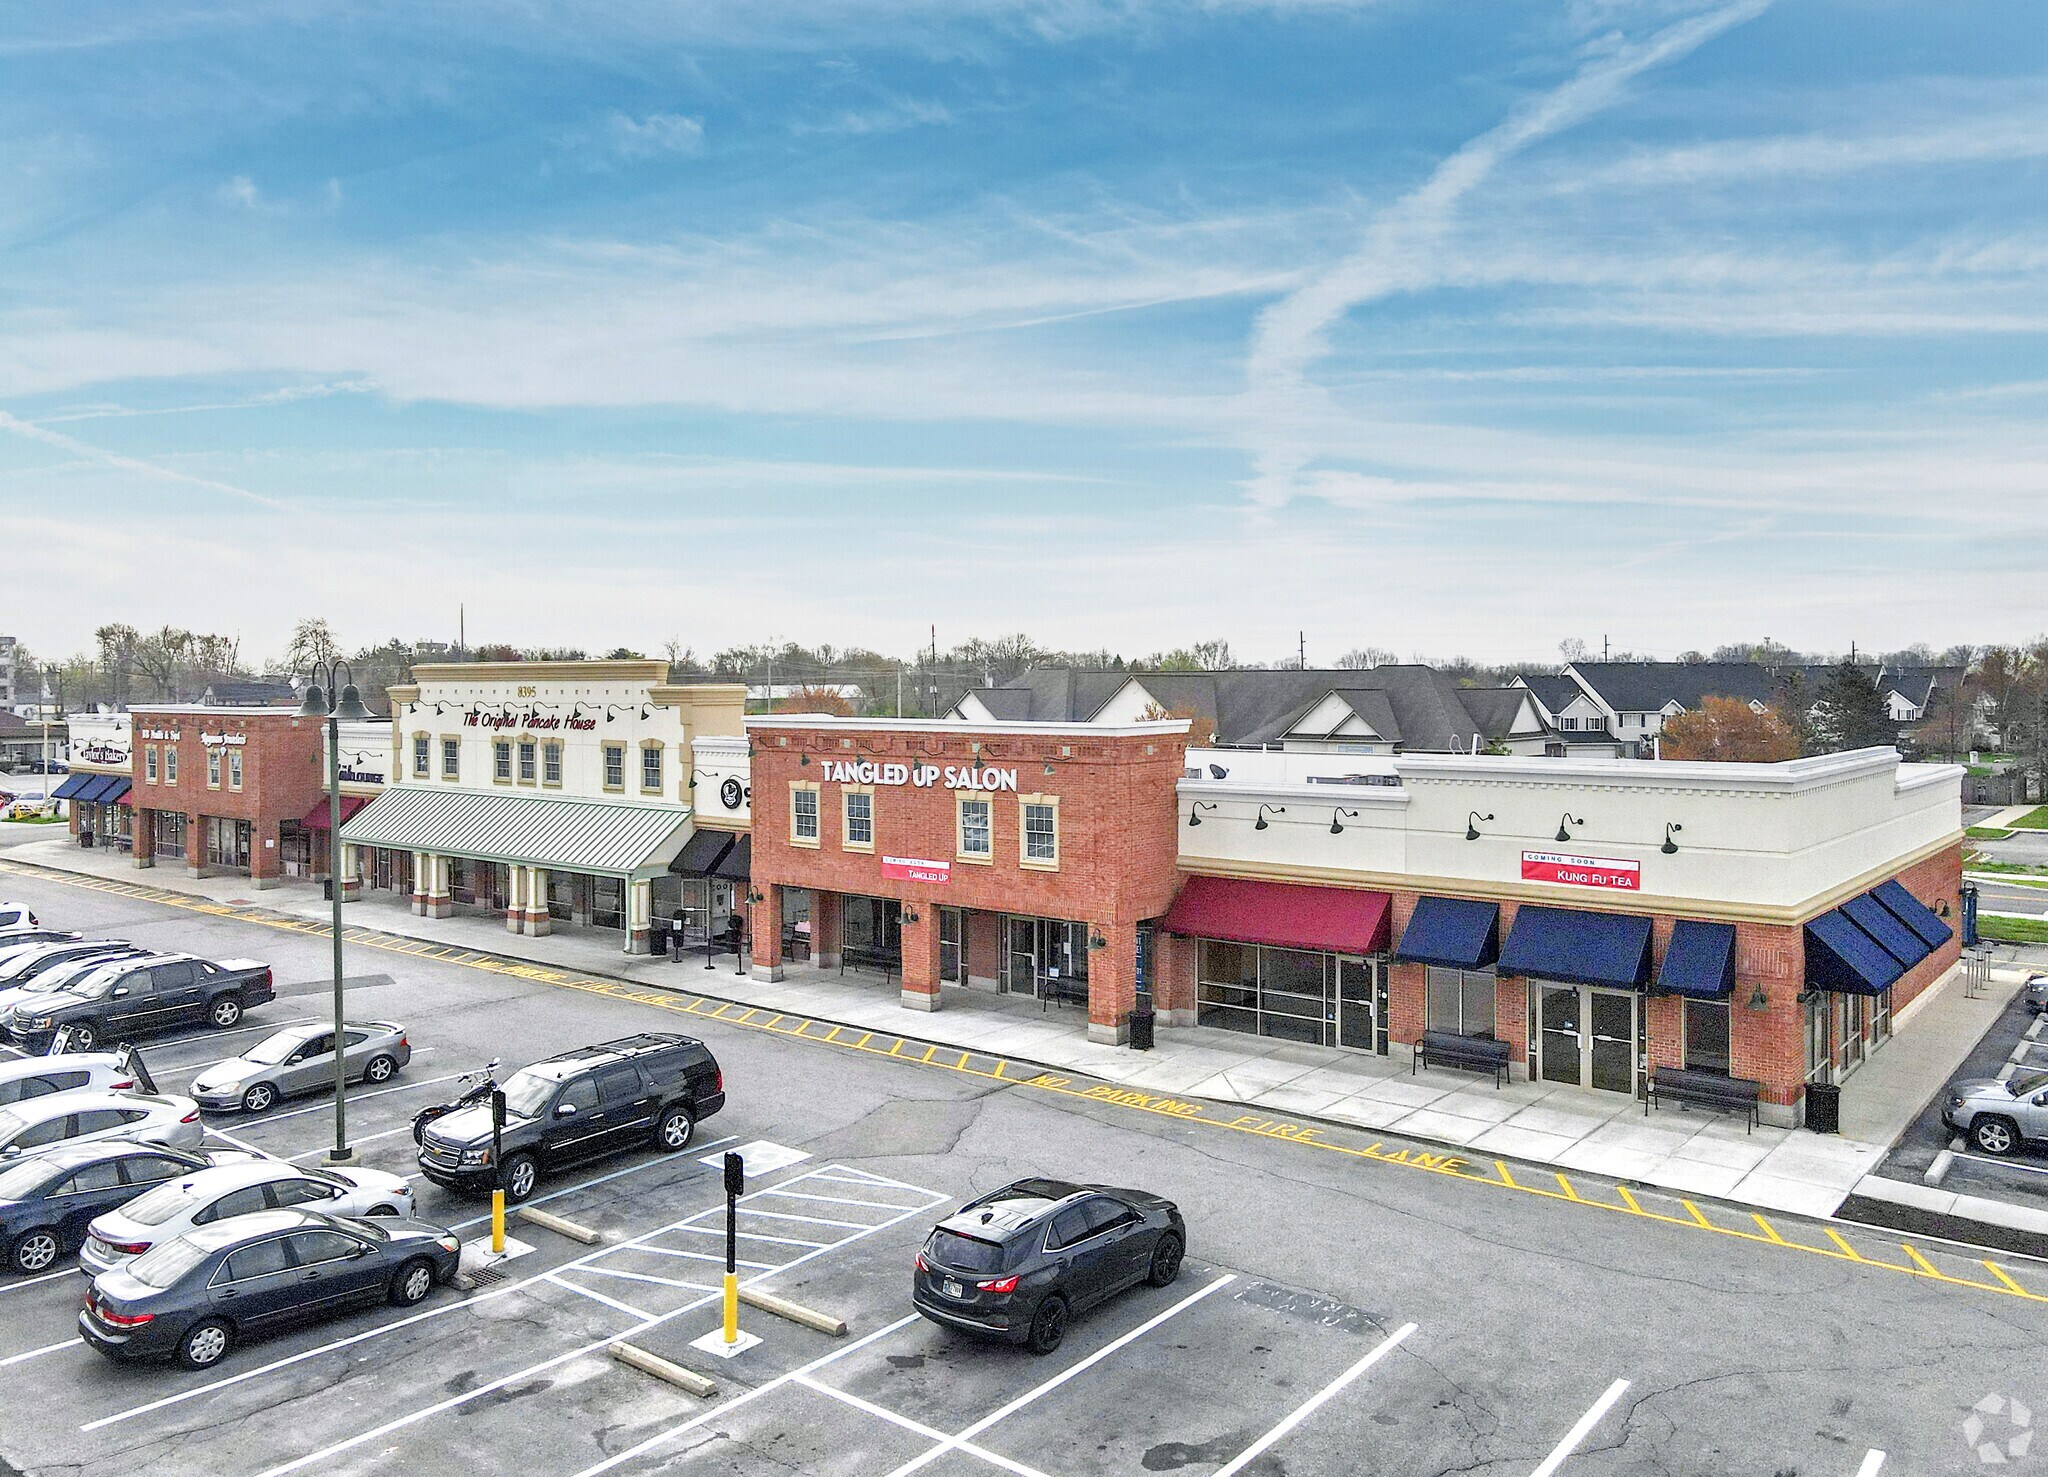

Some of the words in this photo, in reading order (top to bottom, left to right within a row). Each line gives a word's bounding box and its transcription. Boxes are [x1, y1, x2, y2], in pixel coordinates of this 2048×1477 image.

[518, 686, 537, 698] 8395
[464, 712, 478, 726] The
[481, 712, 518, 731] Original
[521, 712, 560, 730] Pancake
[564, 714, 596, 730] House
[821, 760, 909, 786] TANGLED
[912, 765, 940, 787] UP
[944, 765, 1017, 792] SALON
[1528, 854, 1562, 863] COMING
[908, 870, 938, 881] TANGLED
[938, 873, 949, 882] UP
[1557, 870, 1588, 883] KUNG
[1592, 873, 1607, 885] FU
[1610, 875, 1633, 887] TEA
[1027, 1074, 1072, 1087] NO
[1082, 1085, 1203, 1115] PARKING
[1229, 1115, 1325, 1141] FIRE
[1362, 1142, 1470, 1173] LANE
